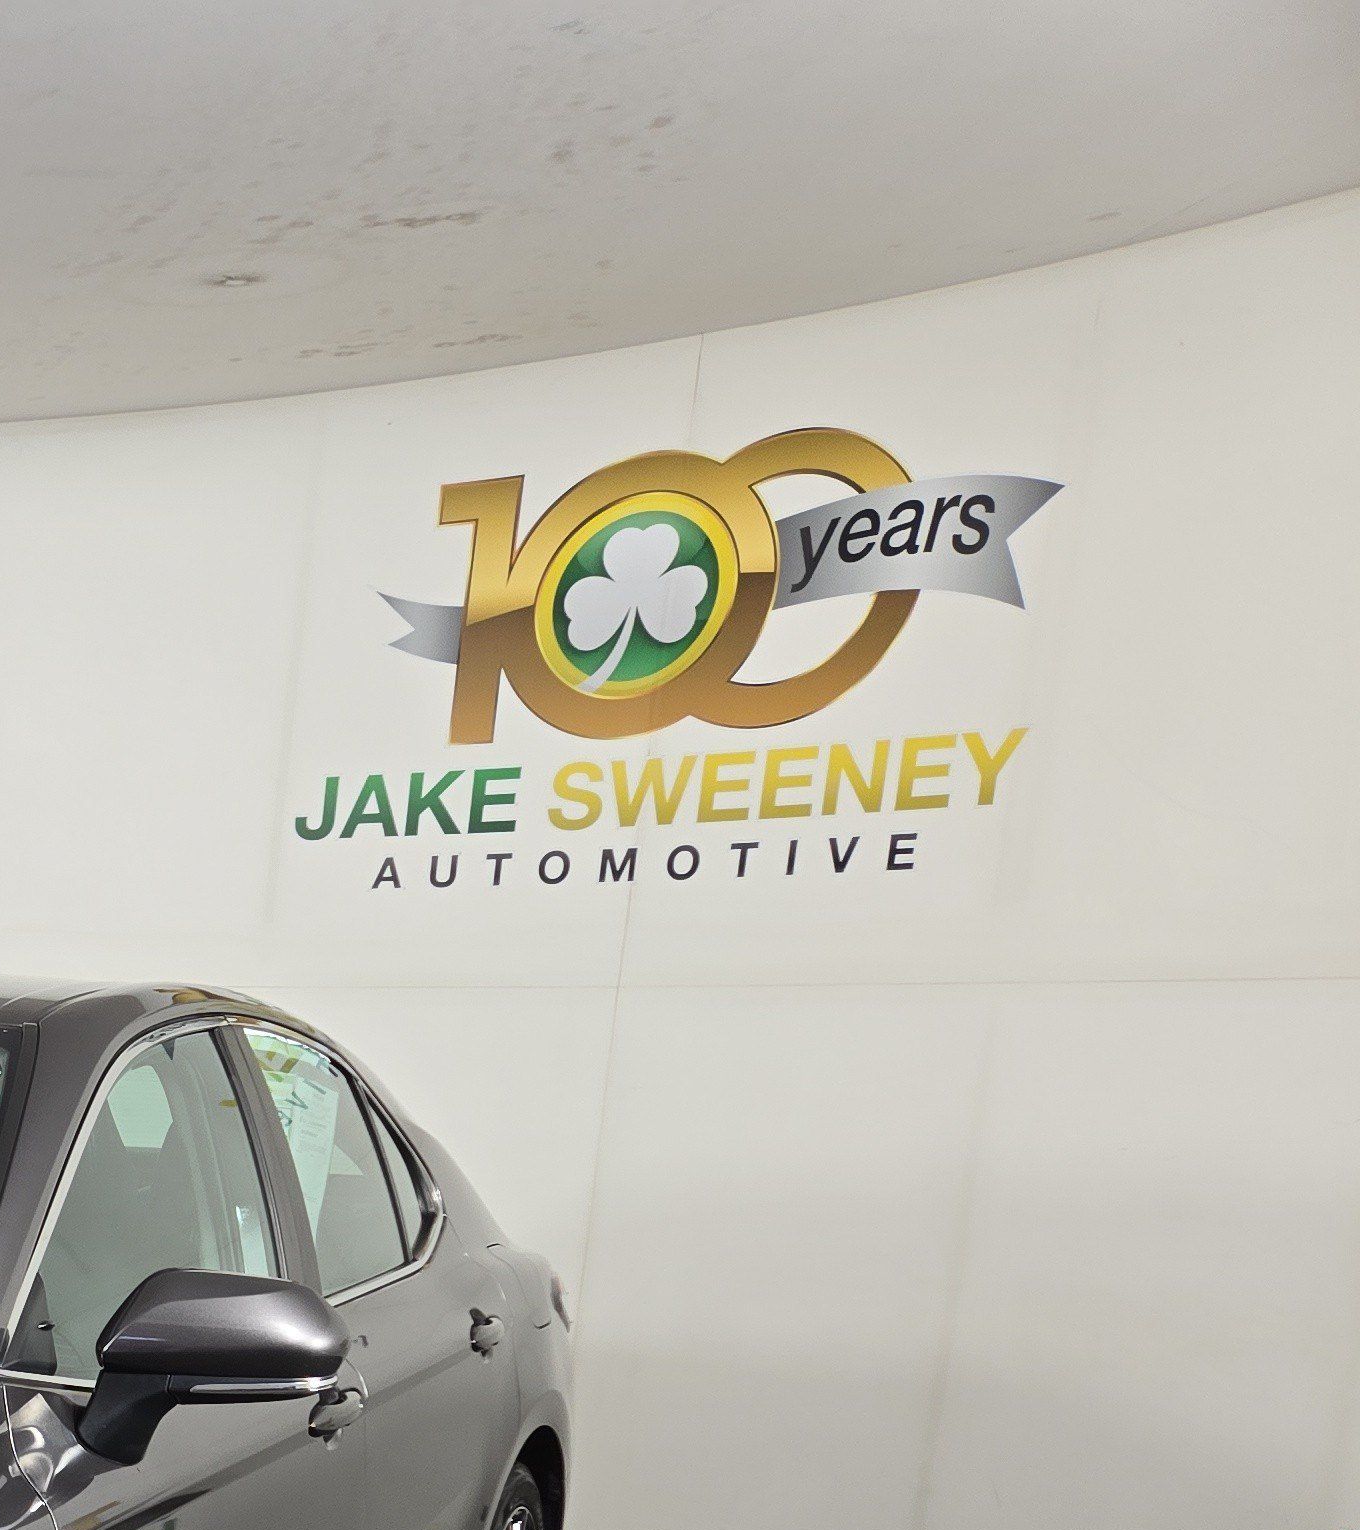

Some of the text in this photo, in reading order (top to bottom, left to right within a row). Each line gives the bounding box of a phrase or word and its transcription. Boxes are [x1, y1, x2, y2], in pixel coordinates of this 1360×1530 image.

[437, 427, 995, 746] 100 years
[294, 727, 1029, 842] JAKE SWEENEY
[371, 832, 918, 890] AUTOMOTIVE
